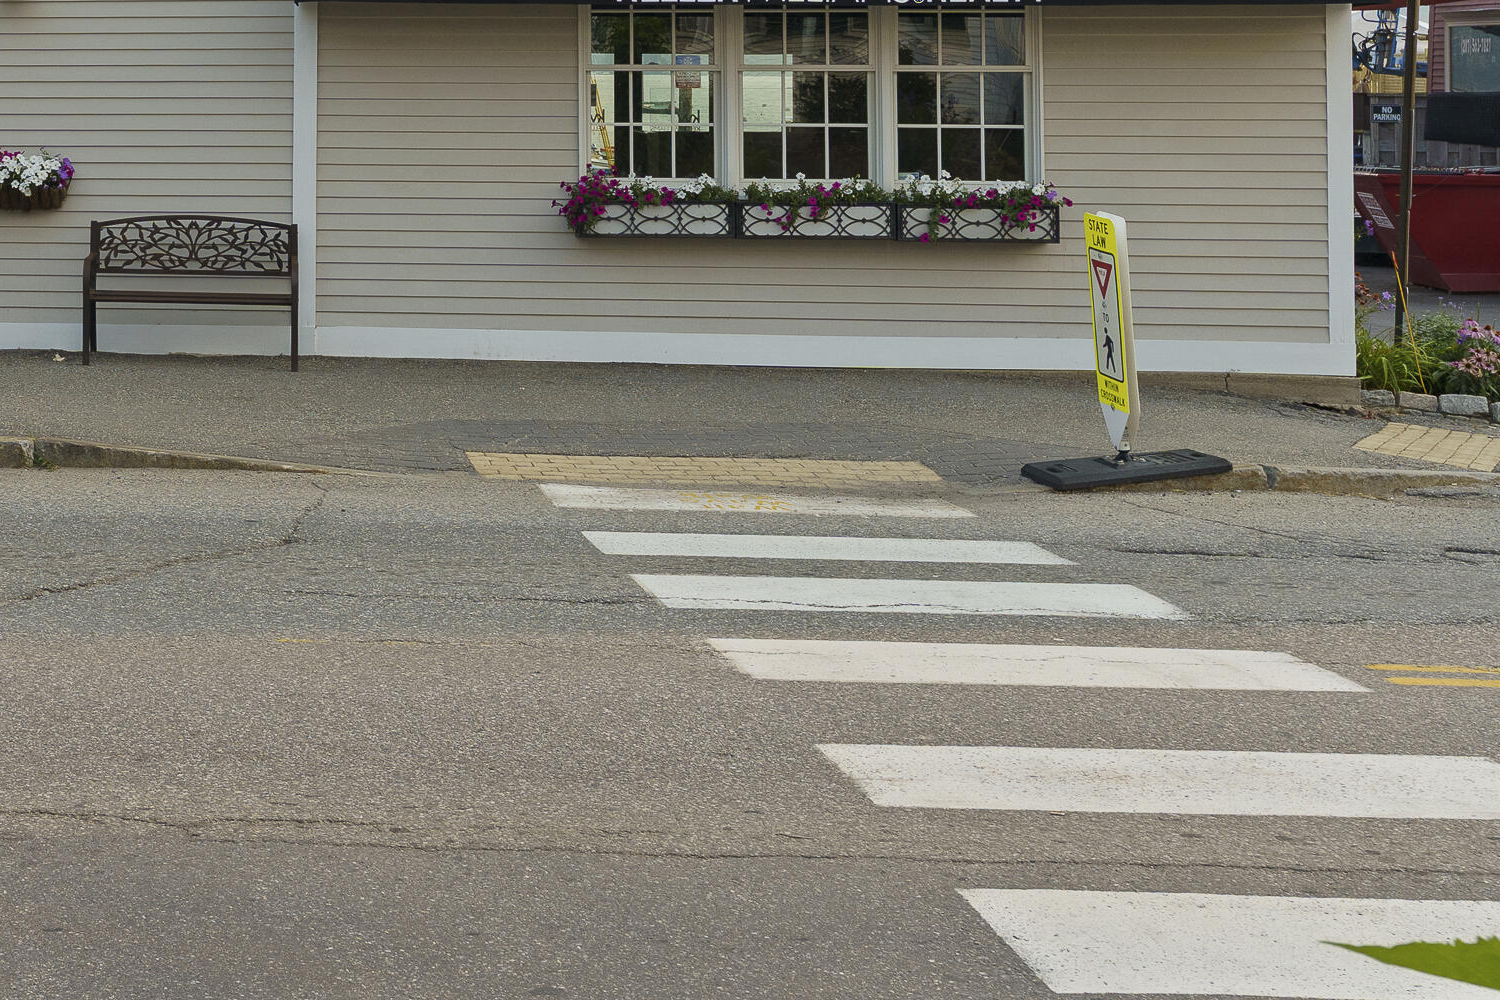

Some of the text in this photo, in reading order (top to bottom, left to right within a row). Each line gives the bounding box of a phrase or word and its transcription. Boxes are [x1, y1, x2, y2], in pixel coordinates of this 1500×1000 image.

[1381, 106, 1393, 114] NO
[1373, 113, 1401, 121] PARKING
[1088, 218, 1109, 235] STATE
[1092, 233, 1107, 249] LAW
